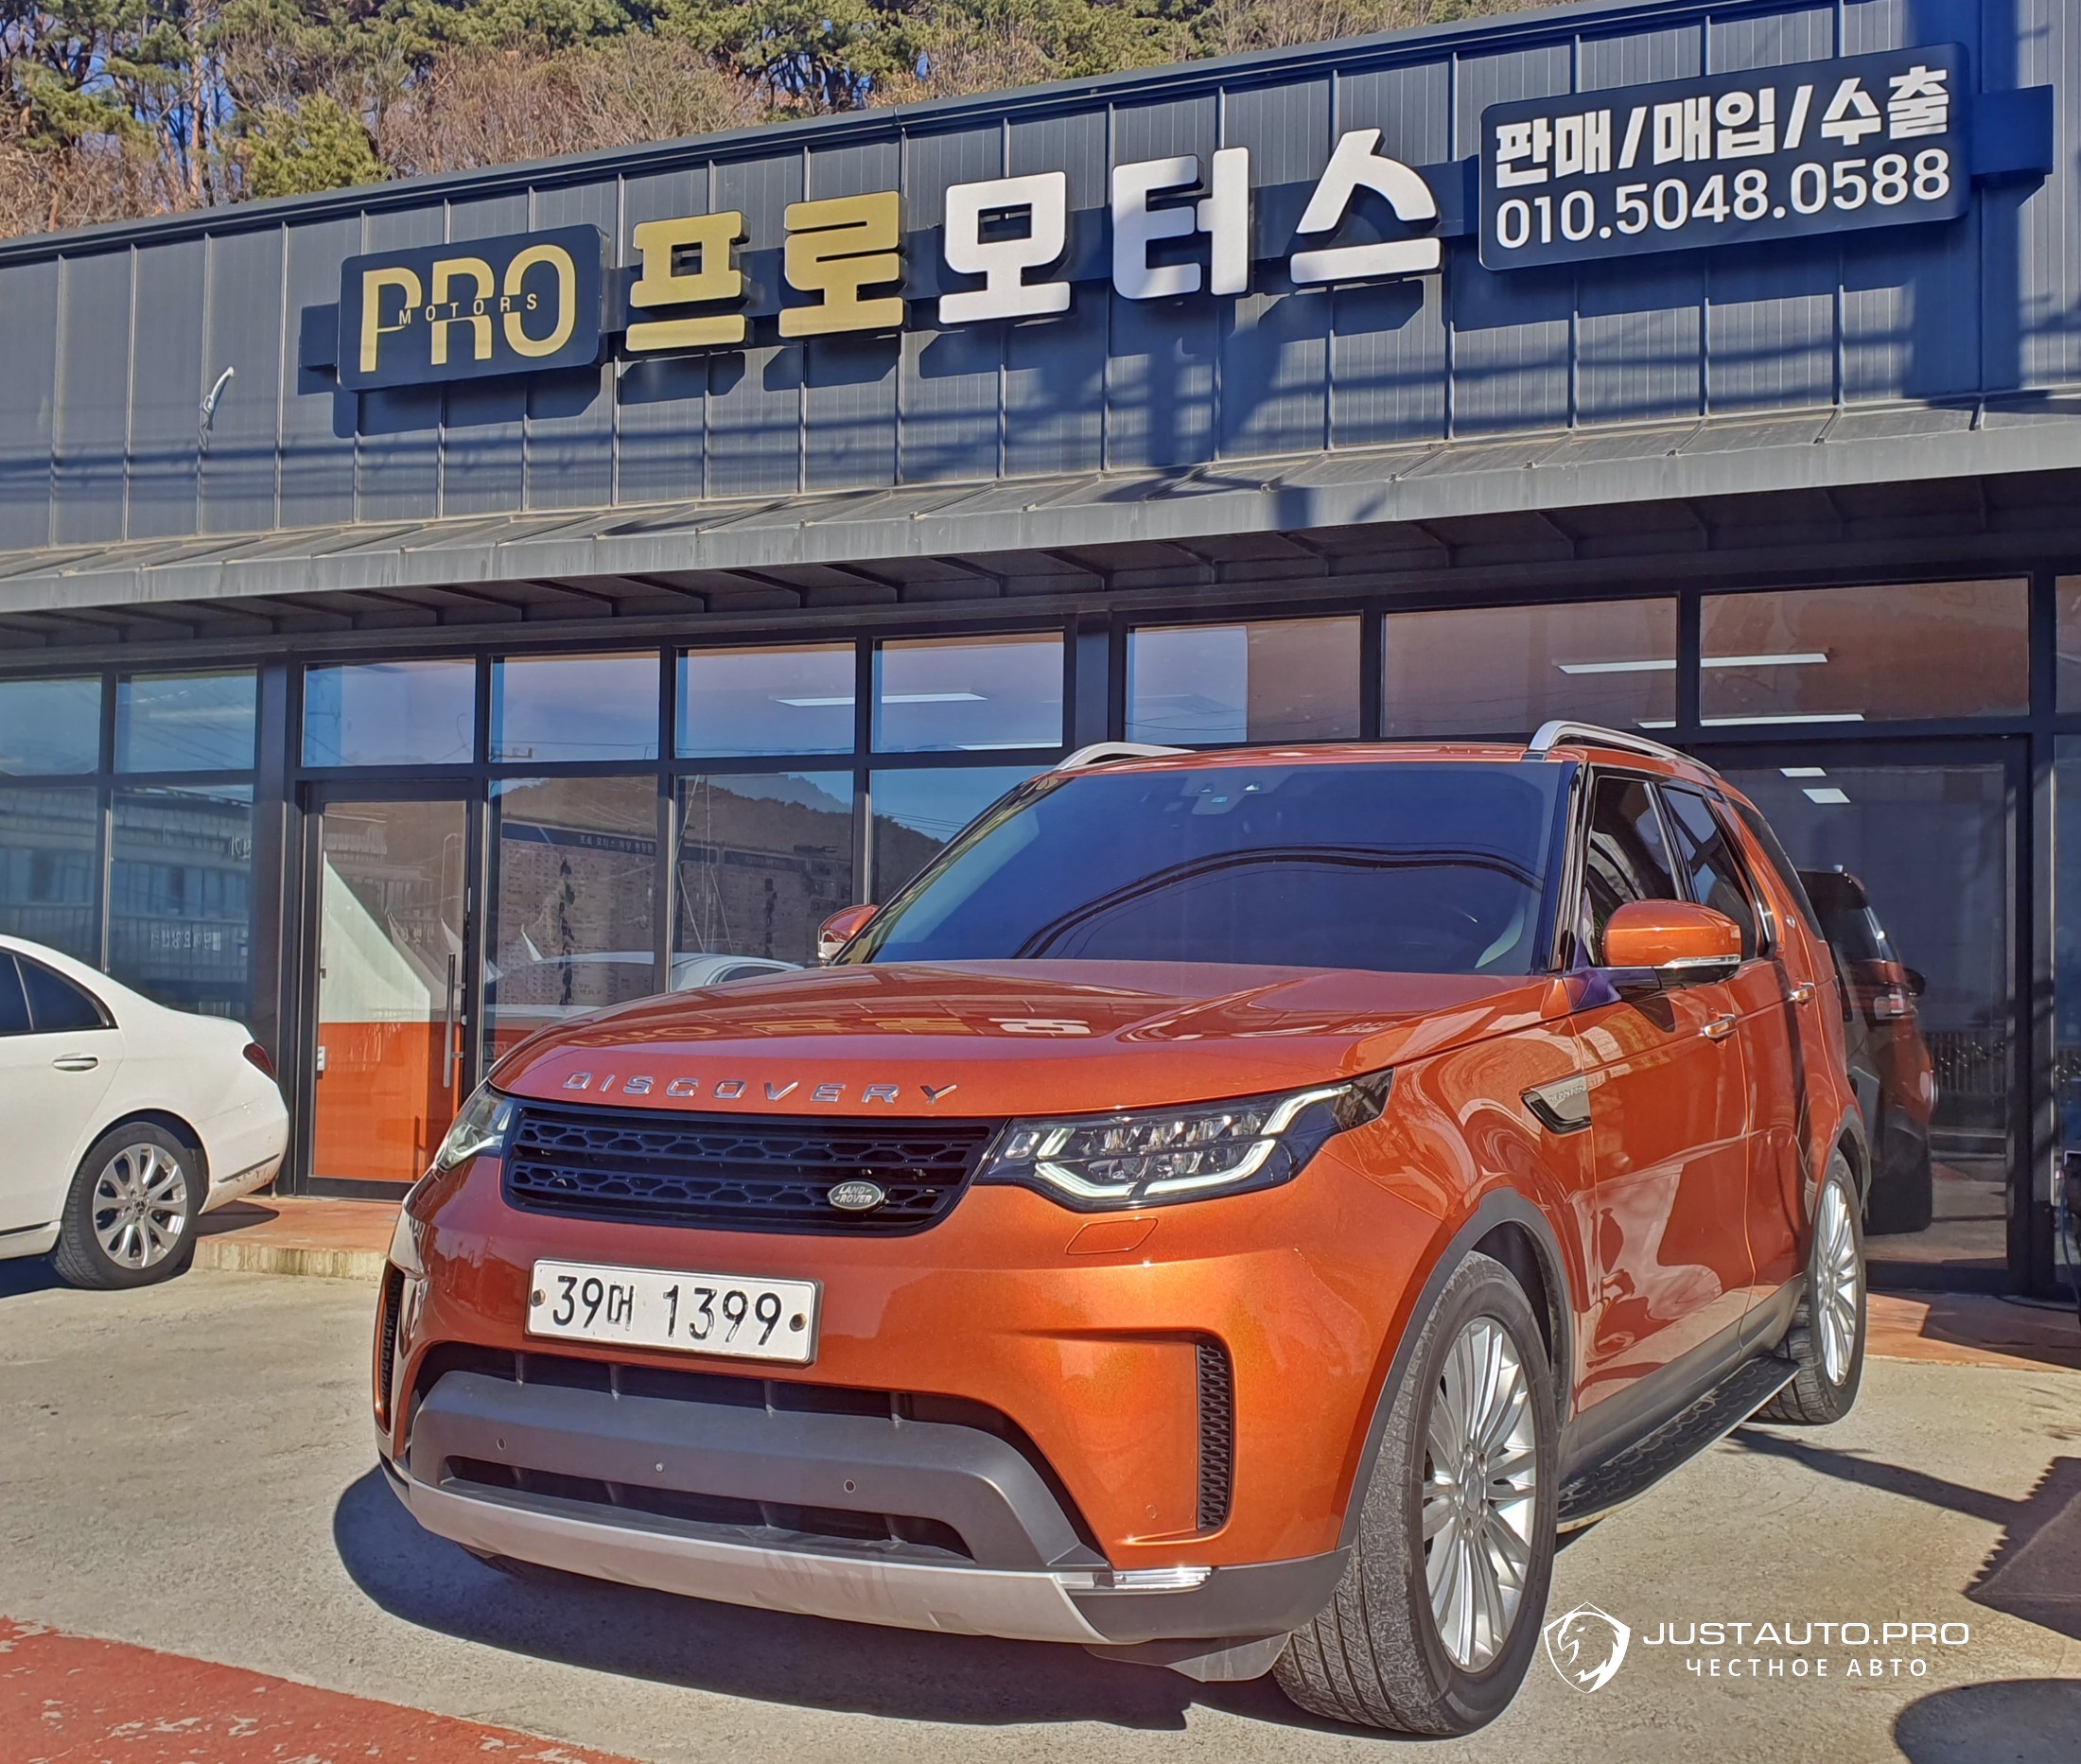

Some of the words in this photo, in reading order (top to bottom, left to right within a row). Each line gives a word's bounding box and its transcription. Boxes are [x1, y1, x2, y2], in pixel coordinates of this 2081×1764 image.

[1495, 66, 1950, 190] 판매/매입/수출
[1496, 148, 1951, 249] 010.5048.0588
[358, 243, 577, 374] PRO
[397, 291, 539, 326] MOTORS
[563, 1072, 957, 1104] DISCOVERY
[839, 1186, 866, 1195] LAND
[840, 1194, 871, 1203] ROVER
[663, 1284, 781, 1346] 1399
